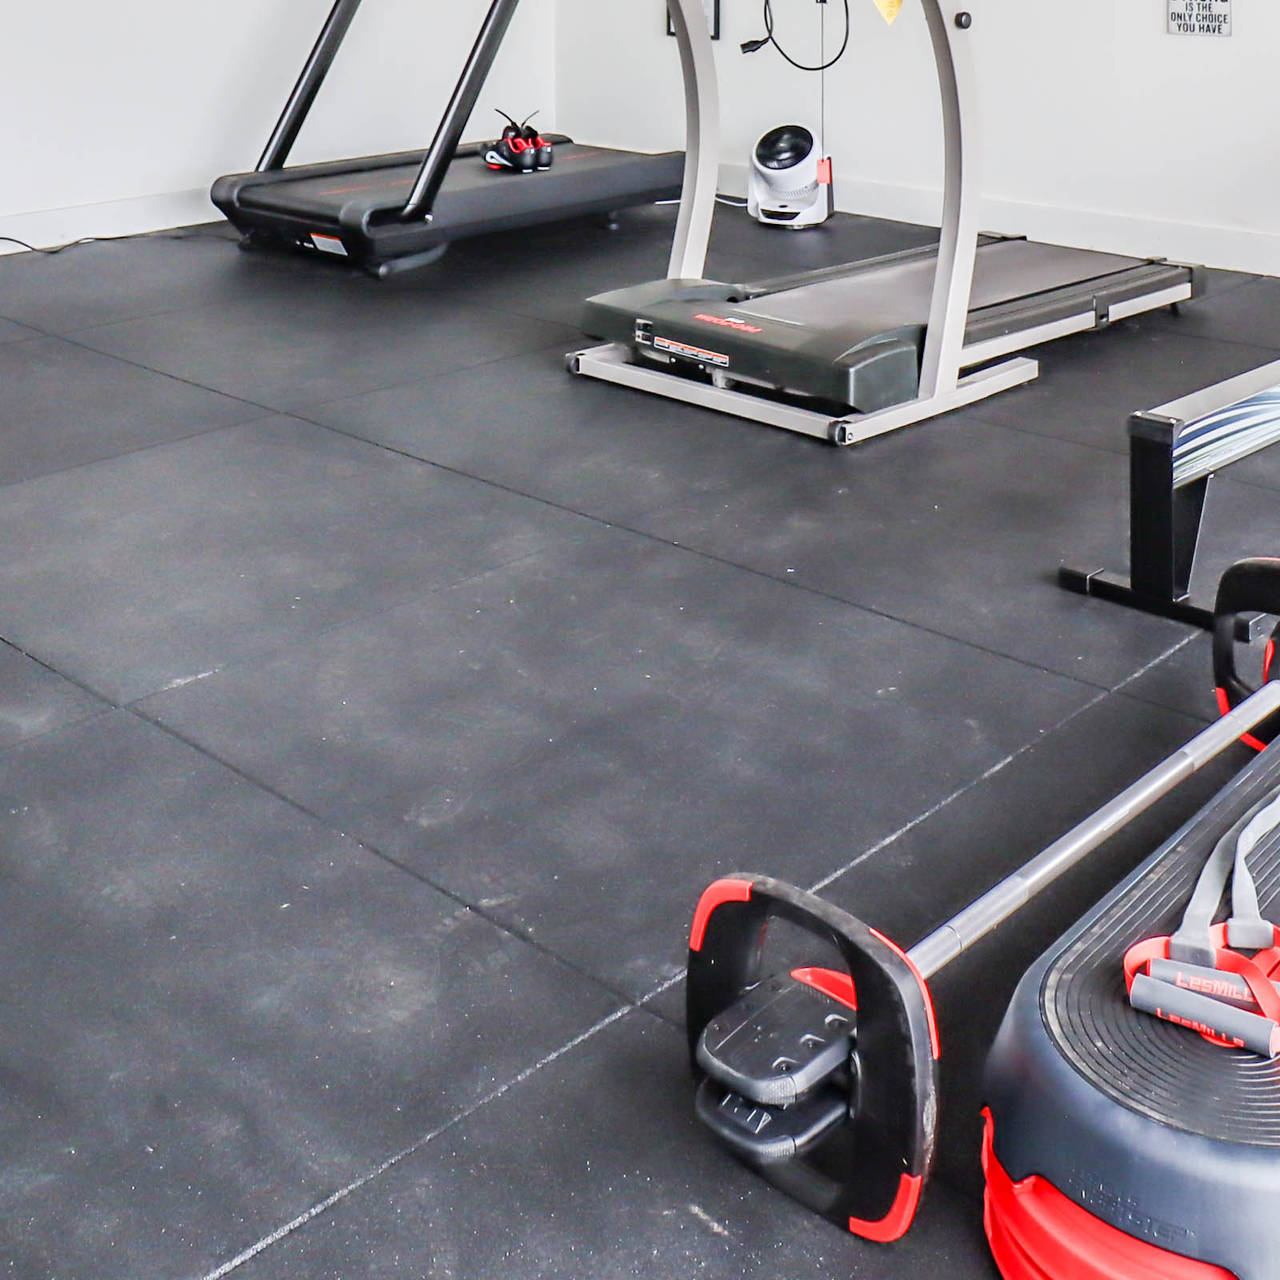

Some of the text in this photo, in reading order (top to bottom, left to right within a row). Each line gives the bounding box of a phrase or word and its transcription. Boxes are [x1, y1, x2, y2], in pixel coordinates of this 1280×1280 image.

[1185, 2, 1212, 12] IS THE
[1170, 12, 1228, 24] ONLY CHOICE
[1177, 23, 1223, 34] YOU HAVE
